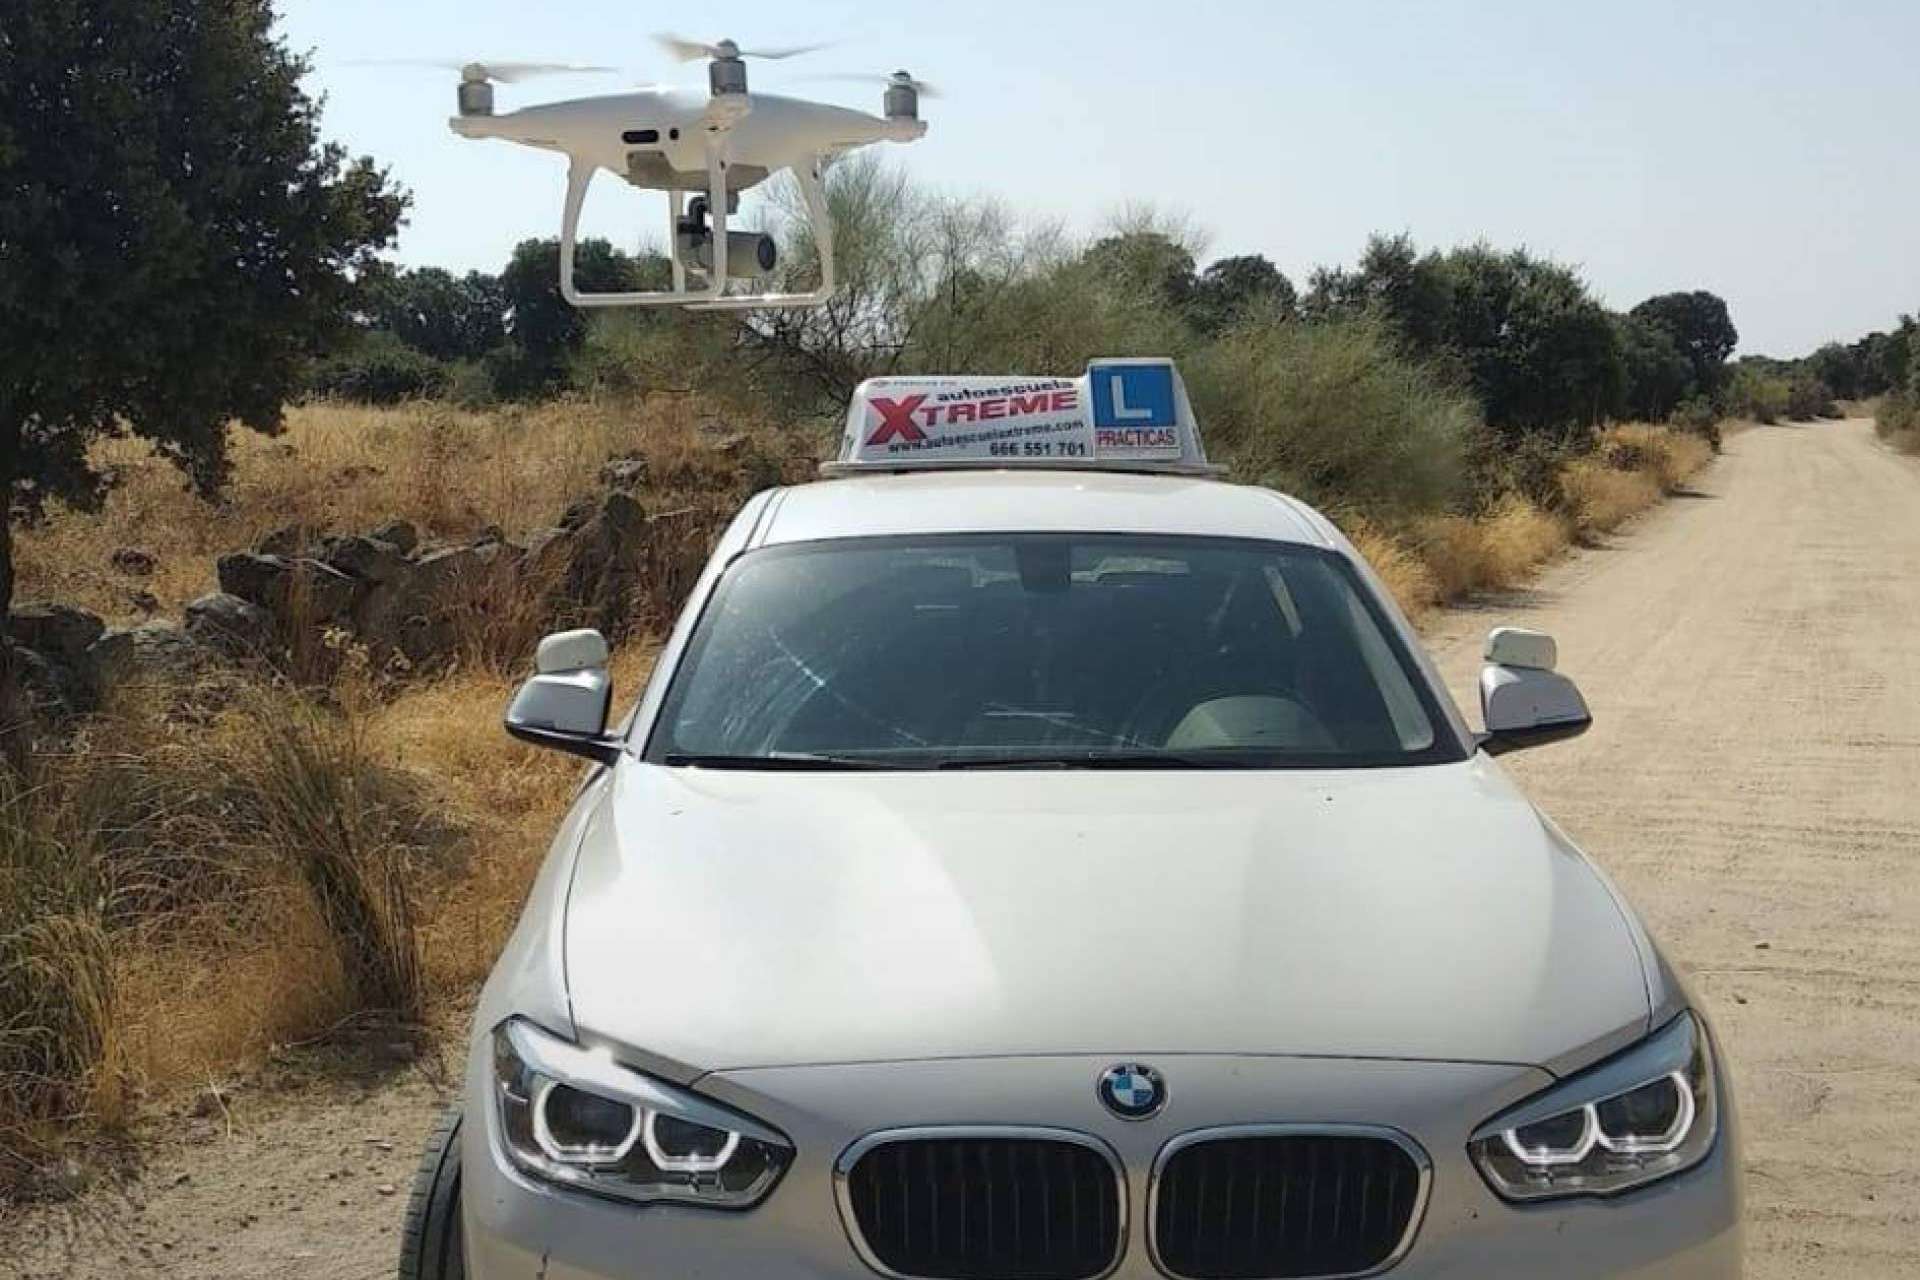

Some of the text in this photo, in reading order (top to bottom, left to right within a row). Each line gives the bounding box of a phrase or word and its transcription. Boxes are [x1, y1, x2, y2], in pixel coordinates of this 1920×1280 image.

[937, 379, 1074, 401] autoescuela
[1110, 375, 1153, 419] L
[866, 389, 1079, 446] XTREME
[989, 441, 1086, 456] 666 551 701
